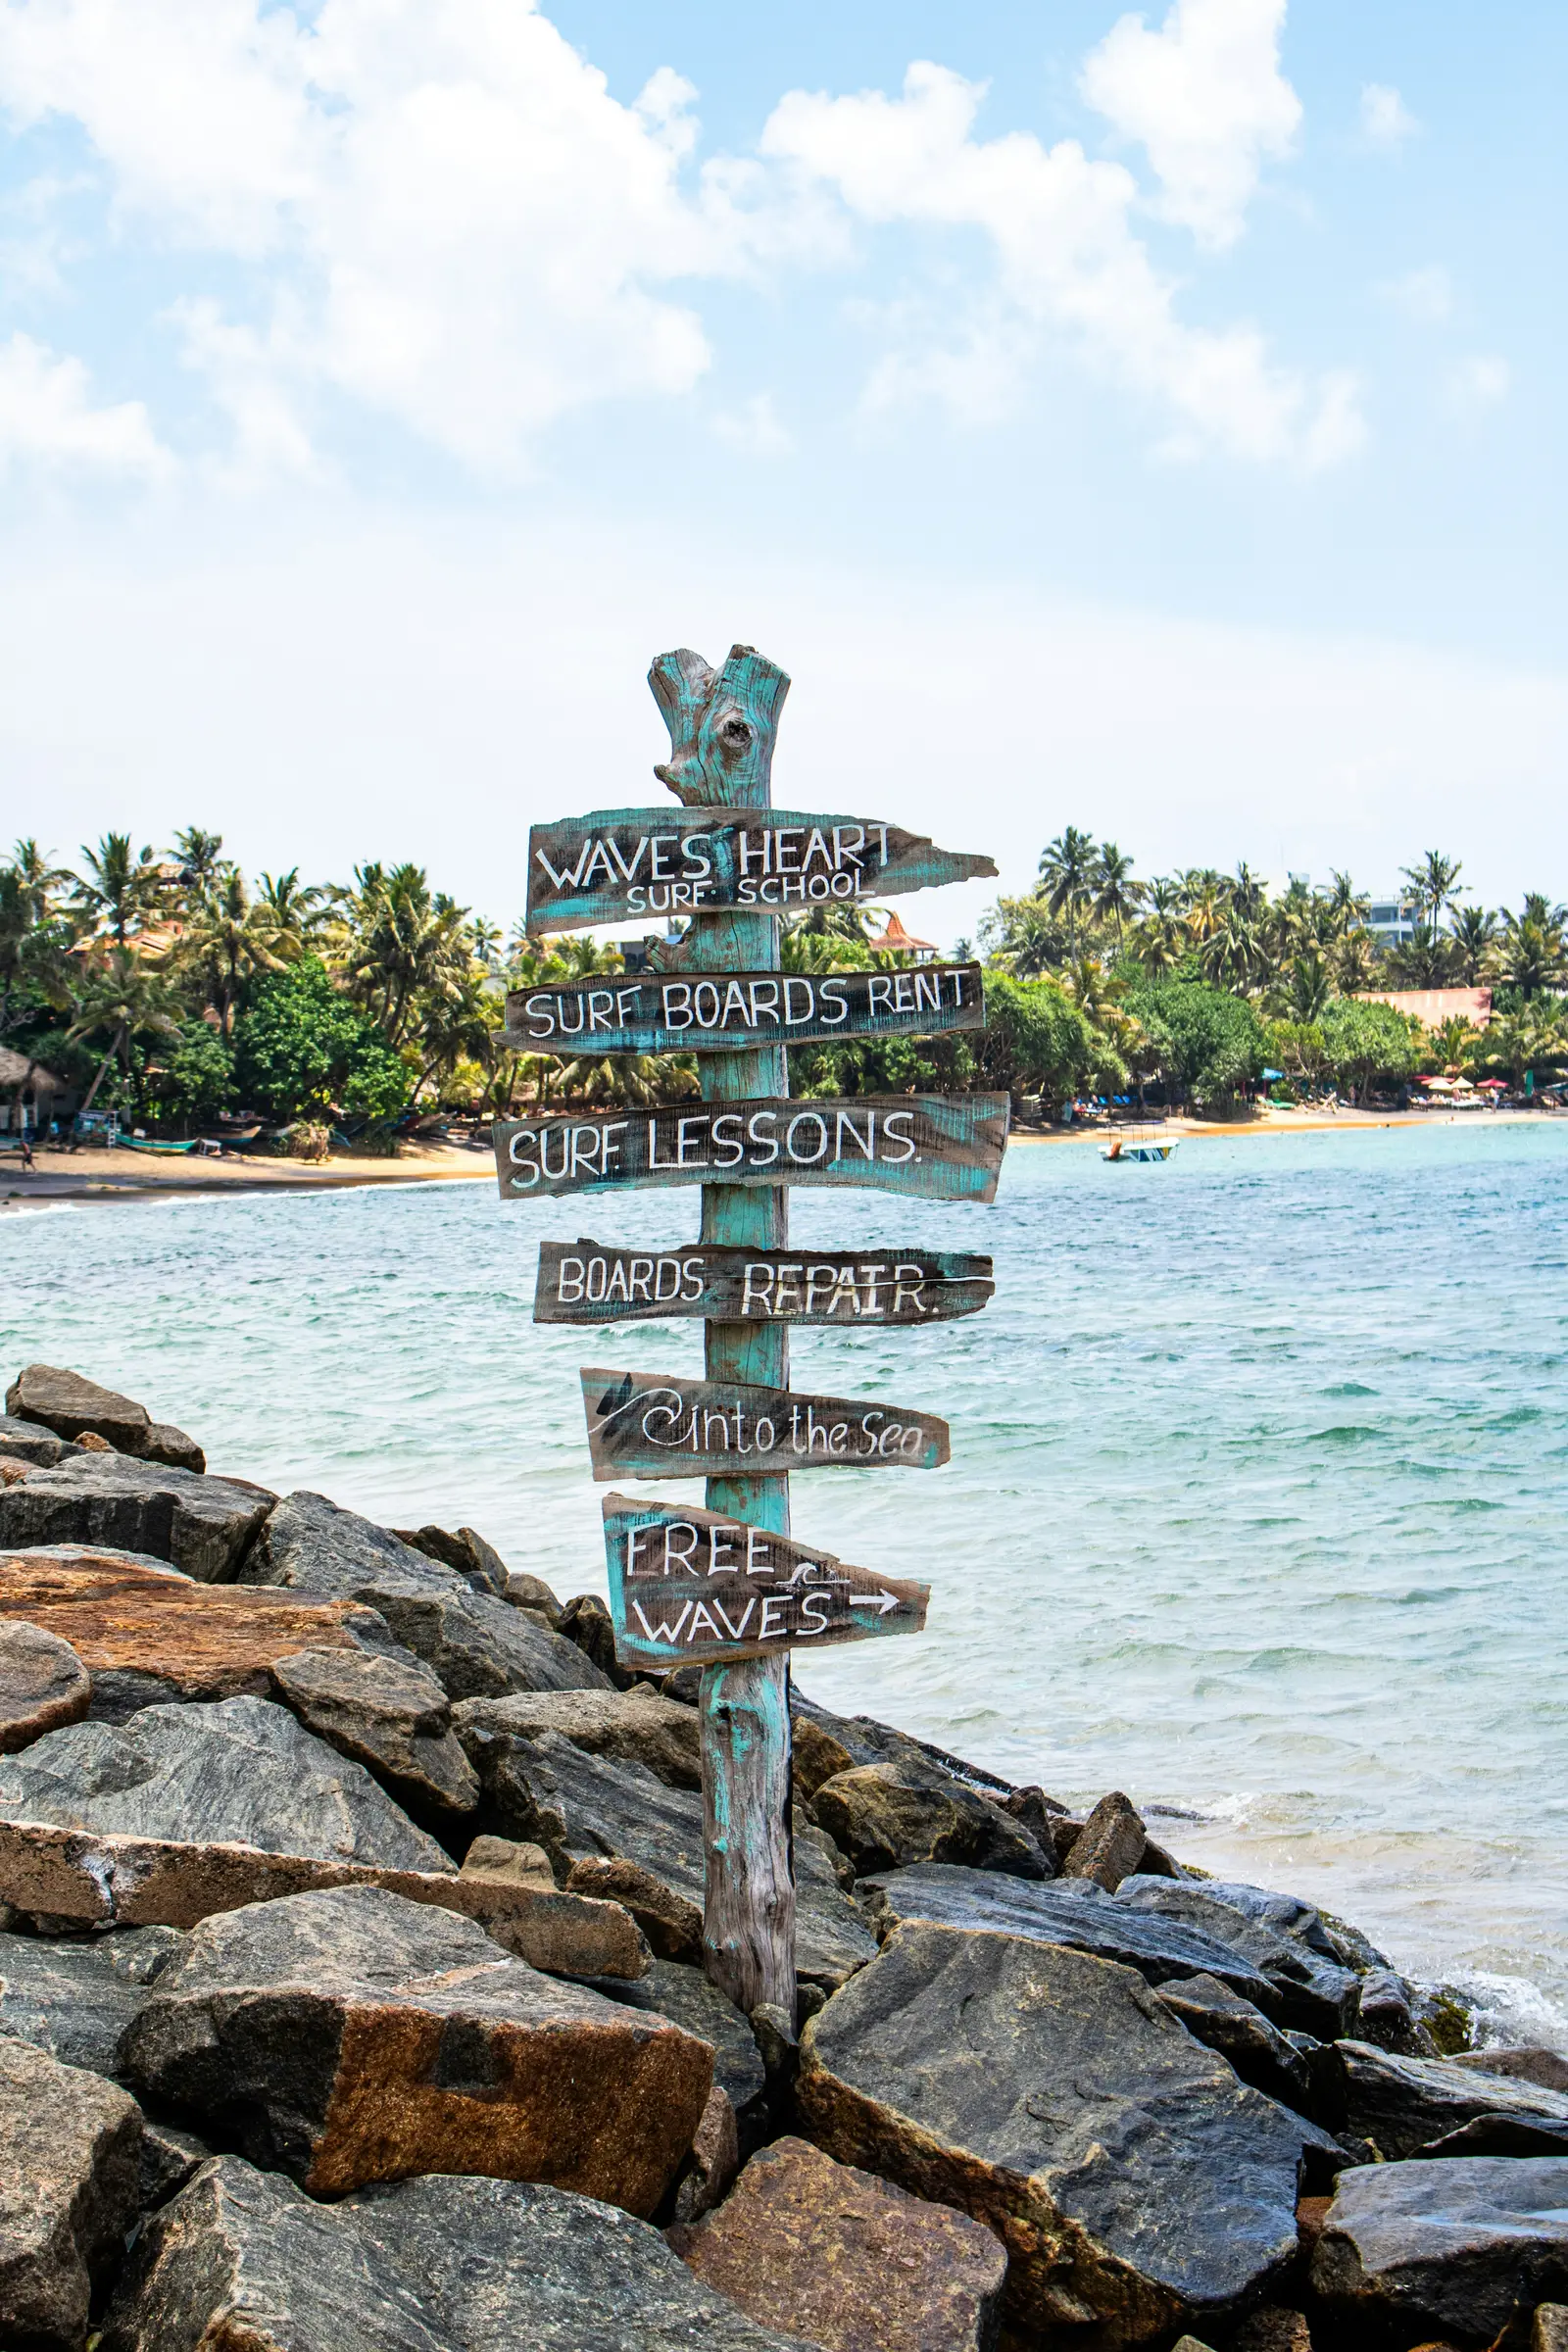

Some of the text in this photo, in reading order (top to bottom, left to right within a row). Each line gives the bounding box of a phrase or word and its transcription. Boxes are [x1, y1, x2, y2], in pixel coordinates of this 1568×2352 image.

[535, 823, 898, 889] WAVES HEART
[737, 868, 875, 904] SCHOOL
[525, 969, 974, 1038] SURF BOARDS RENT.
[509, 1111, 922, 1188] SURF. LESSONS.
[558, 1257, 940, 1315] BOARDS REPAIR.
[788, 1404, 847, 1454] the
[626, 1522, 775, 1577] FREE
[632, 1592, 833, 1642] WAVES
